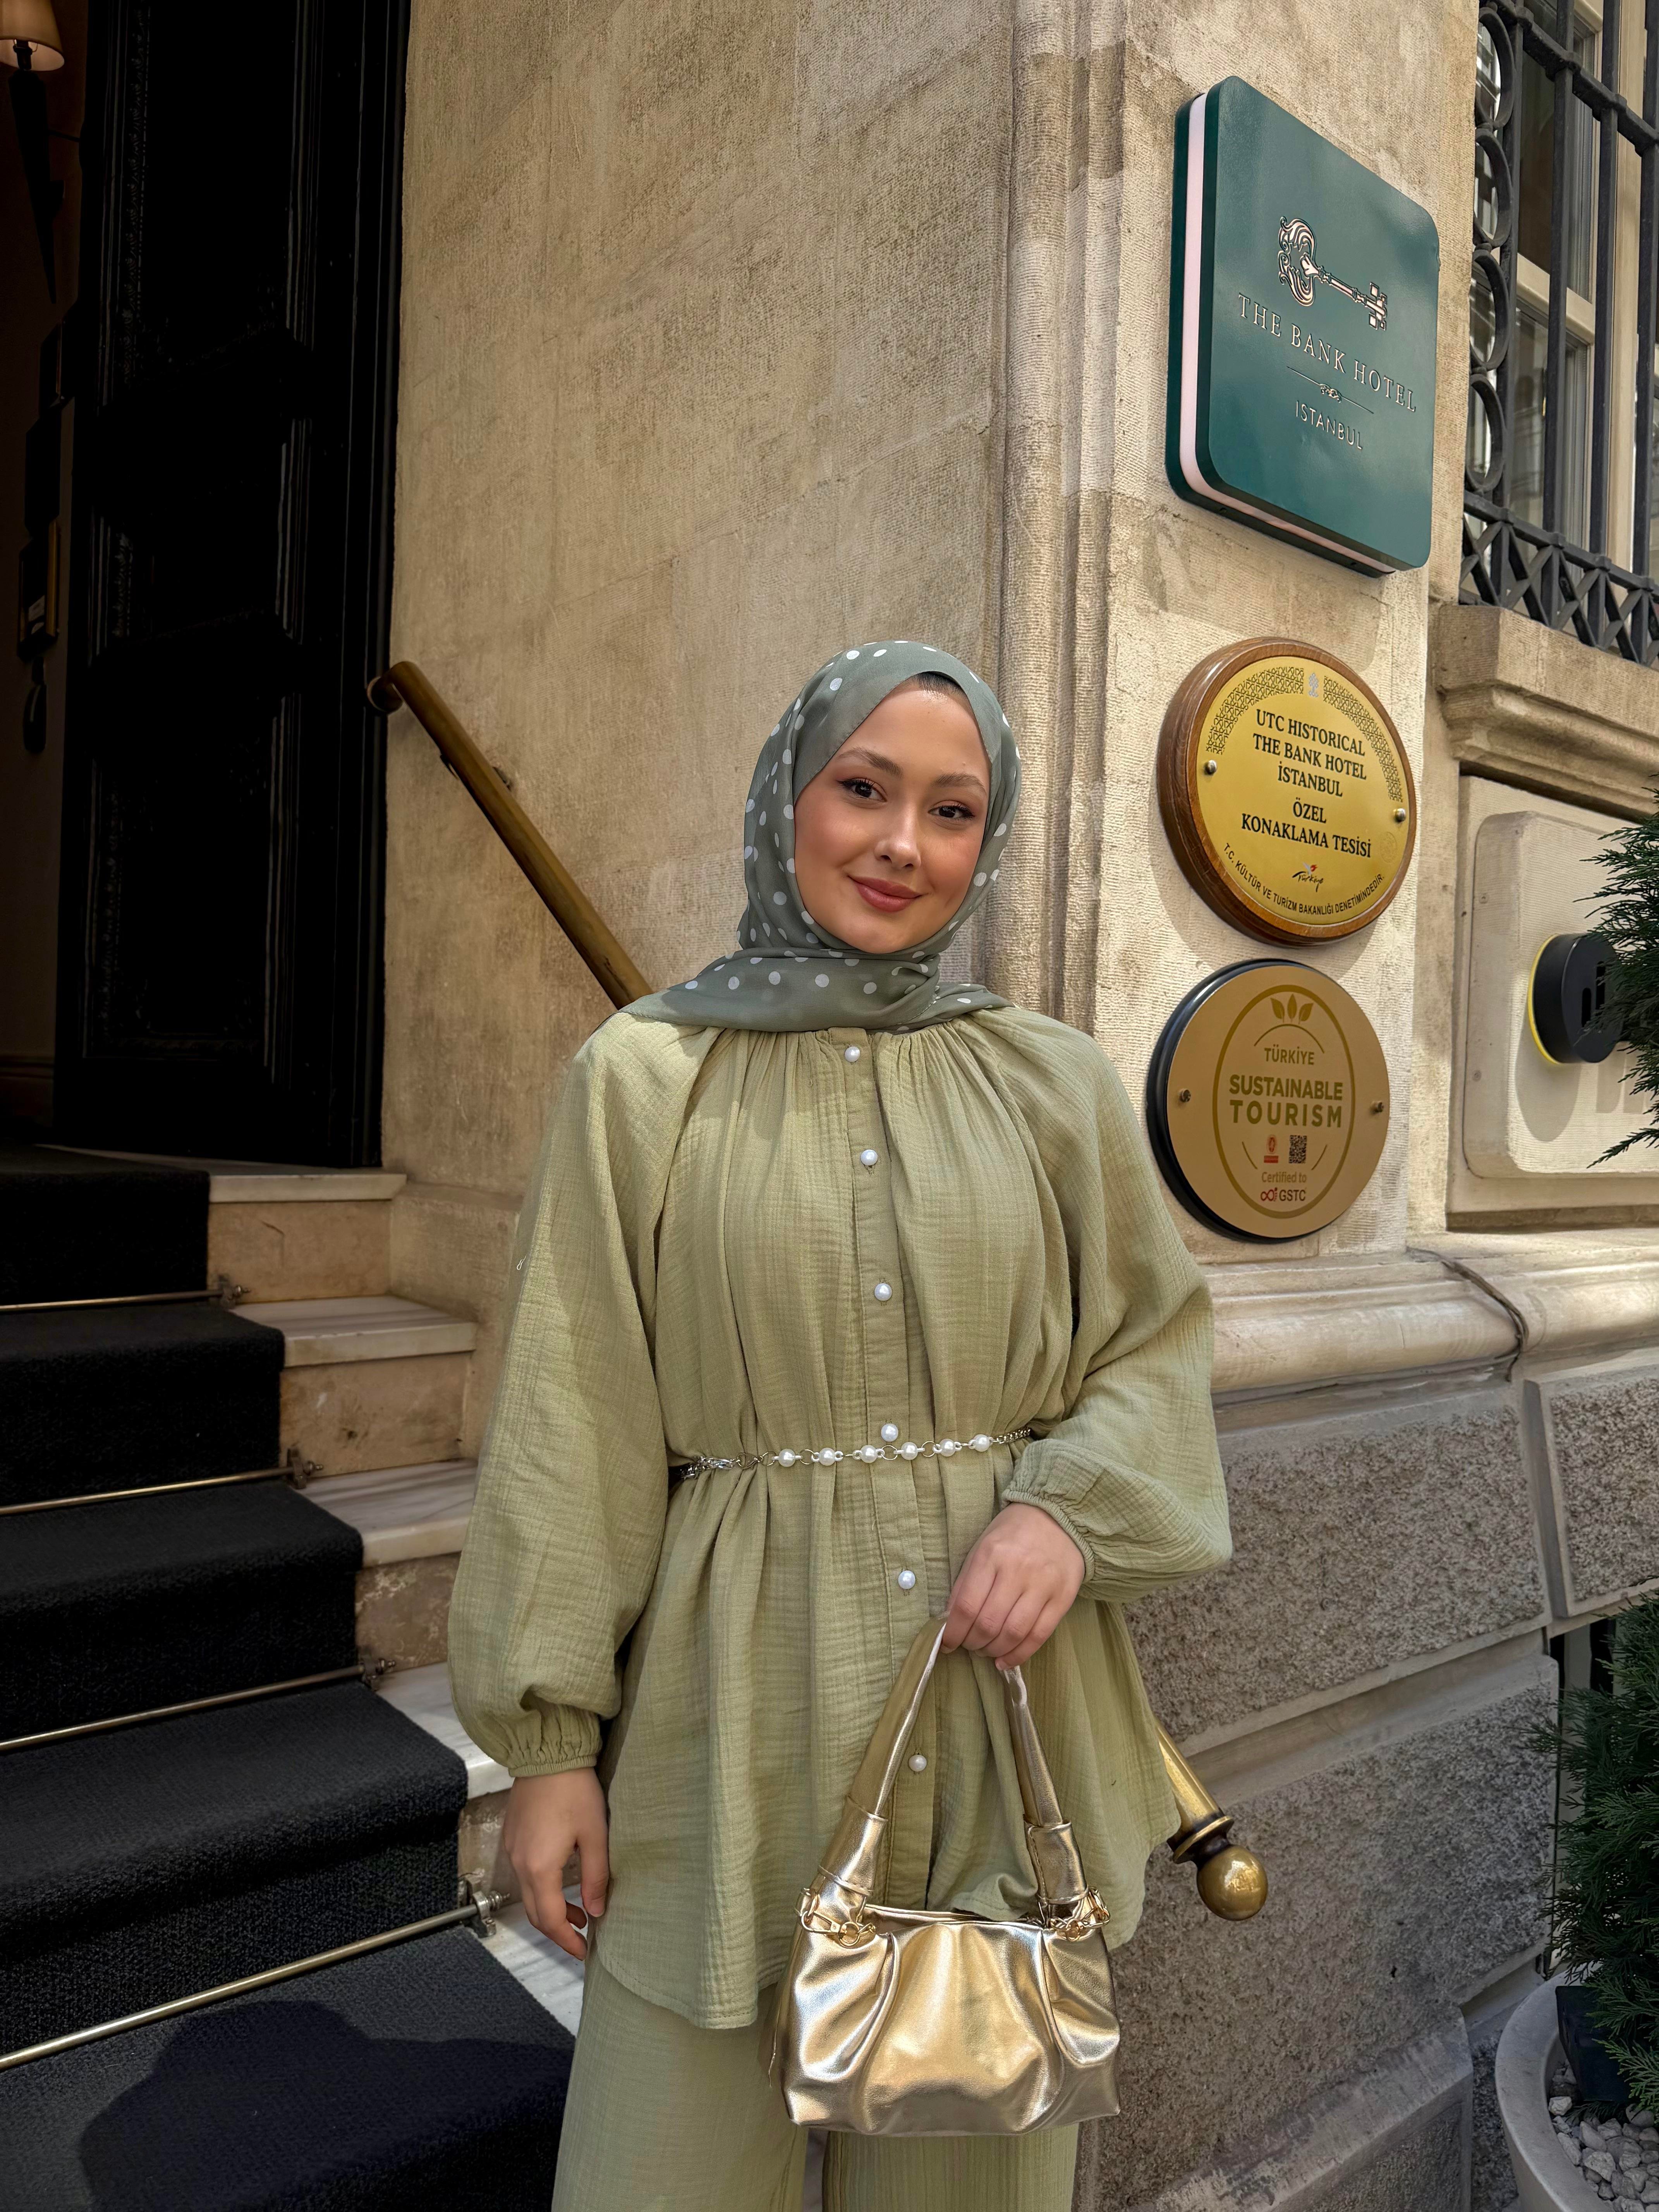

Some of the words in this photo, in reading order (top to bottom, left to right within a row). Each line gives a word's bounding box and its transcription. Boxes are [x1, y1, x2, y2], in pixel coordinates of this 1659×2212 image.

[1238, 293, 1281, 337] THE
[1291, 323, 1346, 374] BANK
[1354, 359, 1416, 412] HOTEL
[1296, 400, 1362, 449] ISTANBUL
[1256, 709, 1284, 732] UTC
[1288, 718, 1365, 756] HISTORICAL
[1253, 733, 1281, 756] THE
[1284, 742, 1321, 768] BANK
[1325, 754, 1366, 780] HOTEL
[1278, 761, 1343, 797] İSTANBUL
[1293, 797, 1327, 823] ÖZEL
[1242, 813, 1329, 848] KONAKLAMA
[1333, 835, 1371, 857] TESİSİ
[1224, 843, 1235, 863] T.C.
[1235, 860, 1261, 891] KÜLTÜR
[1263, 886, 1271, 899] VE
[1273, 893, 1297, 911] TURİZM
[1299, 903, 1334, 915] BAKANLIĞI
[1264, 1044, 1314, 1065] TÜRKİYE
[1229, 1074, 1343, 1101] SUSTAINABLE
[1230, 1100, 1341, 1128] TOURISM
[1262, 1171, 1297, 1183] Certified
[1299, 1173, 1307, 1183] to
[1279, 1189, 1306, 1201] GSTC
